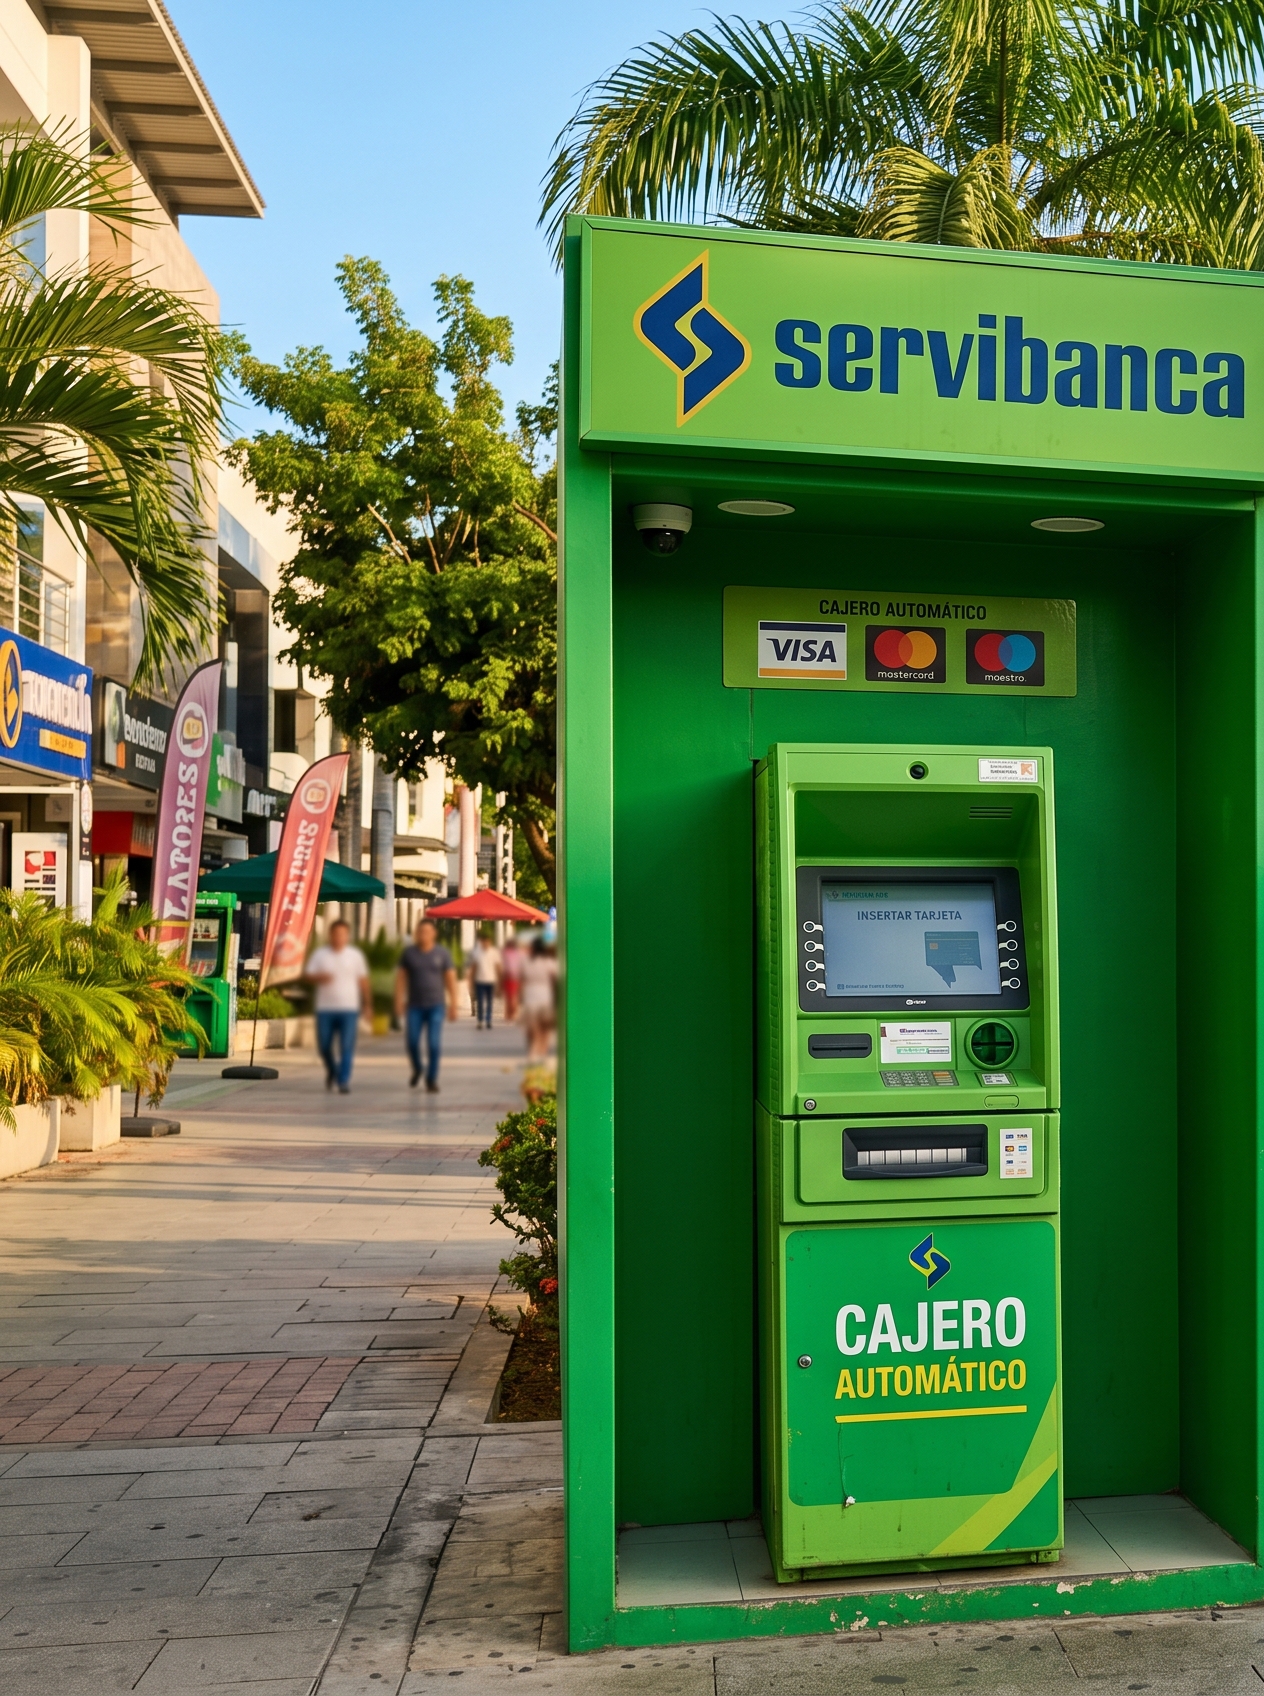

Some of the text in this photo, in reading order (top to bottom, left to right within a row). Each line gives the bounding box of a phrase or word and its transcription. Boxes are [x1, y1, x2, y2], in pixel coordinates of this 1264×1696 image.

[775, 313, 1245, 419] servibanca
[819, 599, 987, 621] CAJERO AUTOMÁTICO
[766, 638, 837, 663] VISA
[877, 670, 935, 680] mastercard
[857, 910, 963, 921] INSERTAR TARJETA
[835, 1297, 1026, 1356] CAJERO
[835, 1356, 1027, 1400] AUTOMÁTICO
